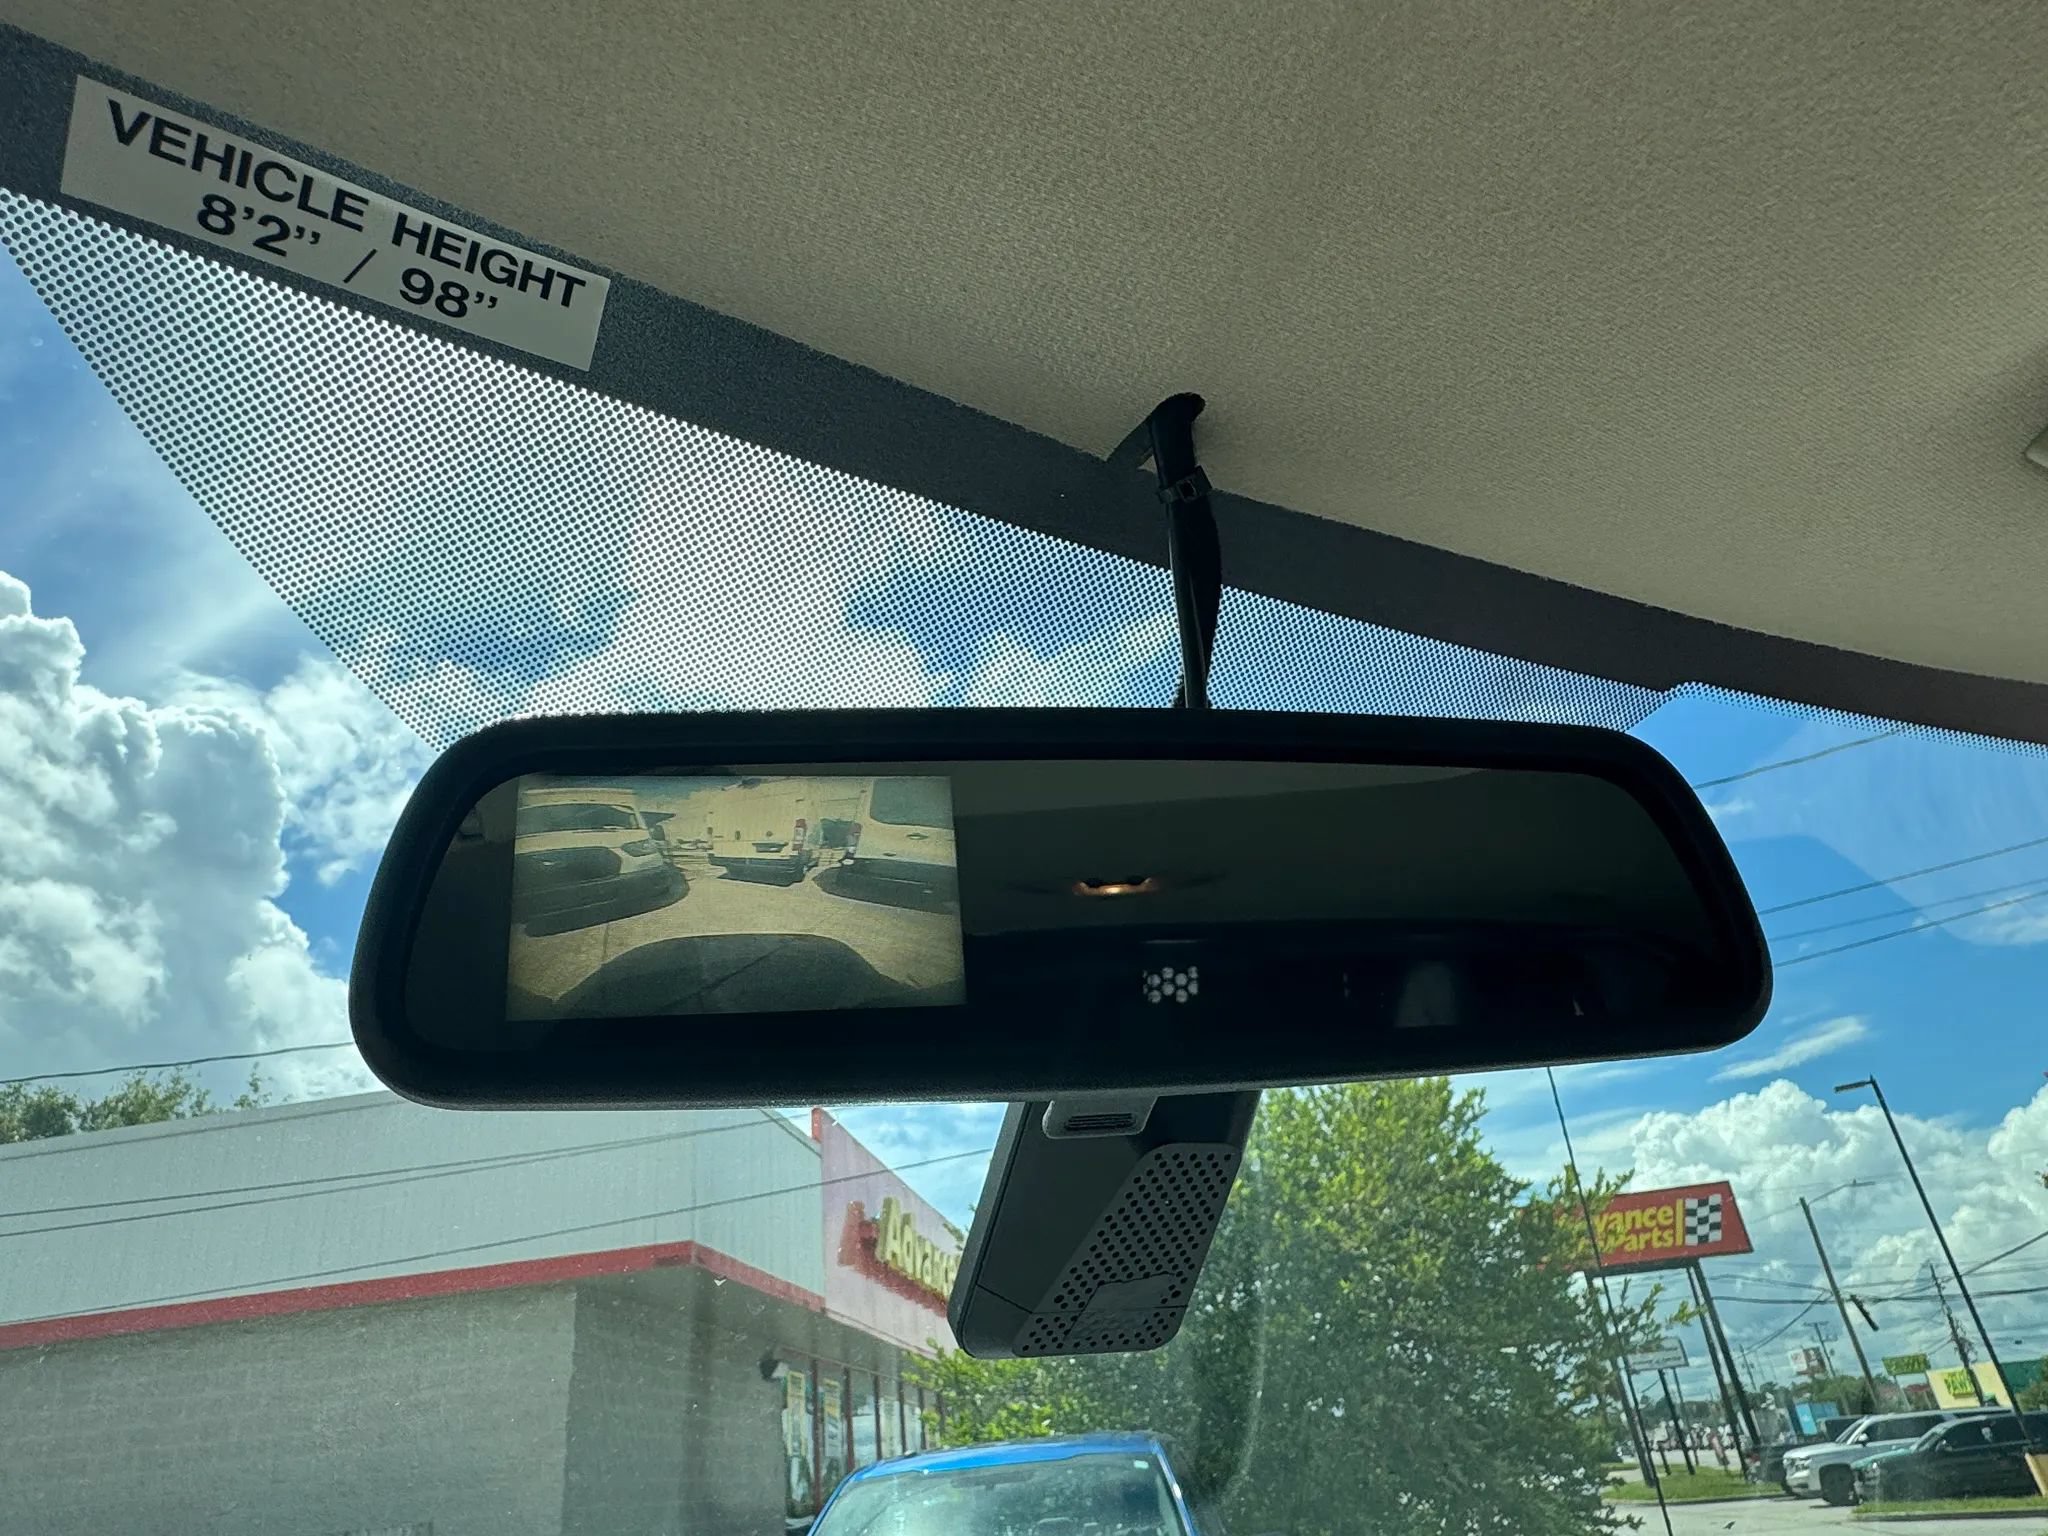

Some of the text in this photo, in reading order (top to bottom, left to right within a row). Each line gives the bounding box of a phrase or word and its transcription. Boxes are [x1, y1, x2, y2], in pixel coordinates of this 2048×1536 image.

[107, 97, 587, 309] VEHICLE HEIGHT
[1592, 1204, 1675, 1235] vance
